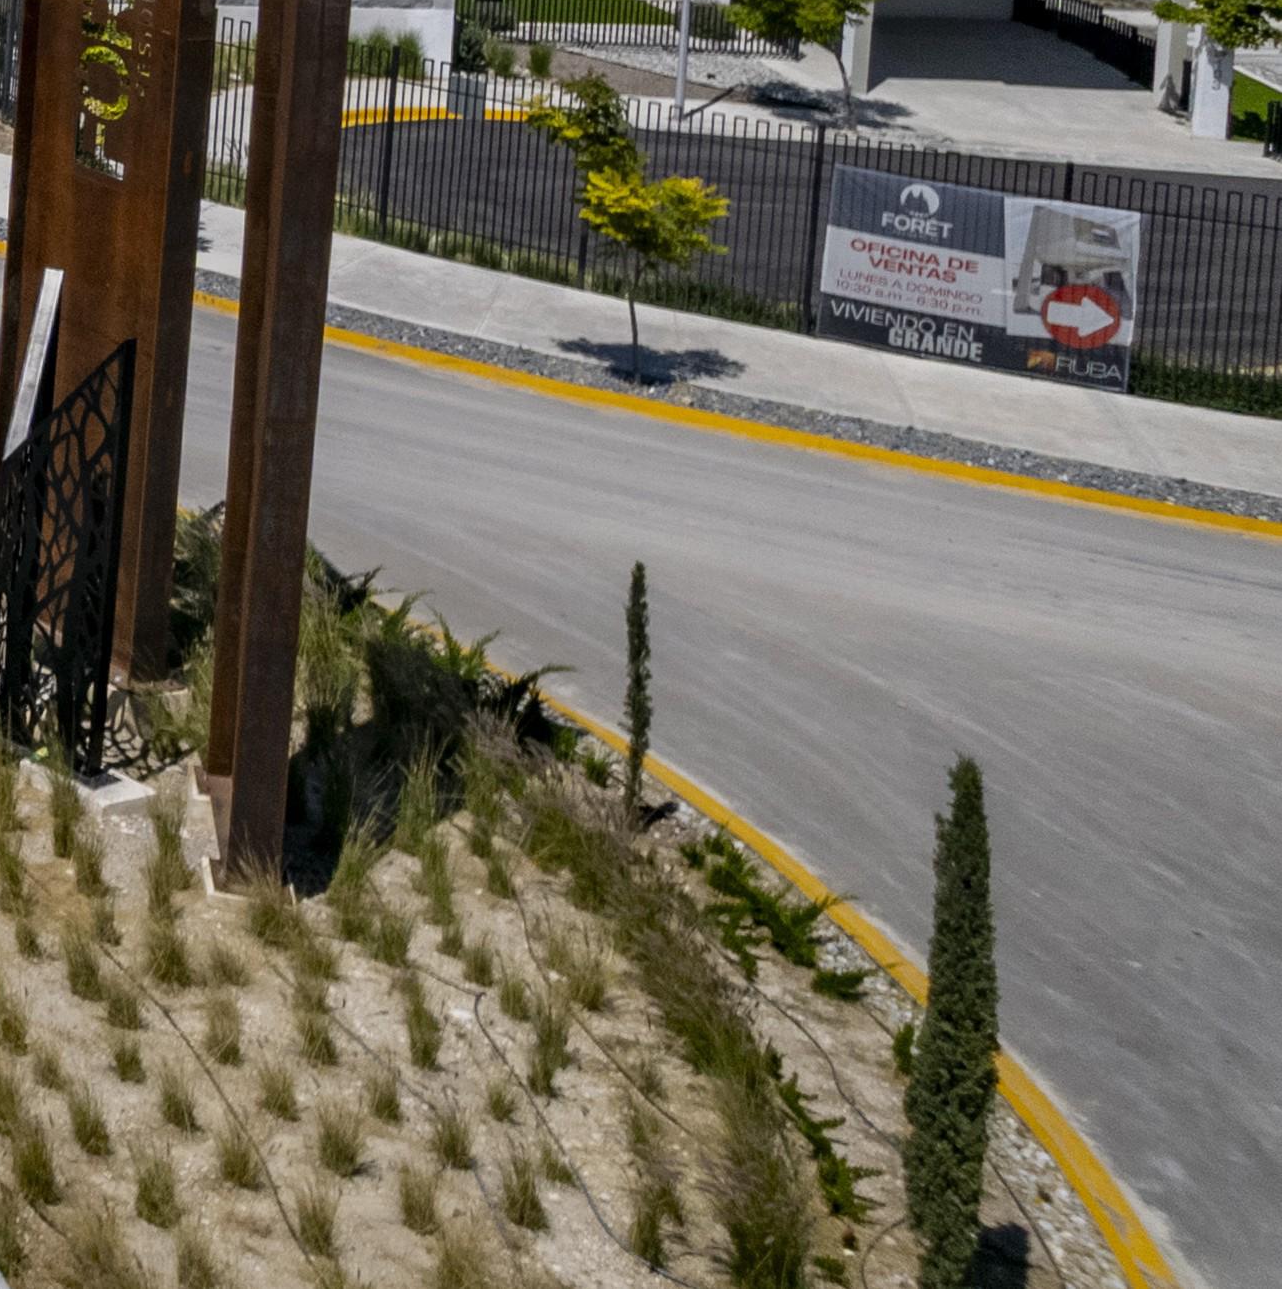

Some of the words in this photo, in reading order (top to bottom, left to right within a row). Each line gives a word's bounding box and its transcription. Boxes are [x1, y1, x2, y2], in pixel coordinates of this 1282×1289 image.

[850, 238, 940, 266] OFICINA
[947, 256, 979, 274] DE
[869, 255, 956, 283] VENTAS
[835, 279, 871, 295] 10:30
[839, 268, 888, 287] LUNES
[892, 278, 903, 290] A
[906, 281, 983, 305] DOMINGO
[830, 300, 937, 334] VIVIENDO
[943, 322, 975, 342] EN
[888, 326, 984, 361] GRANDE
[1055, 355, 1122, 381] RUBA
